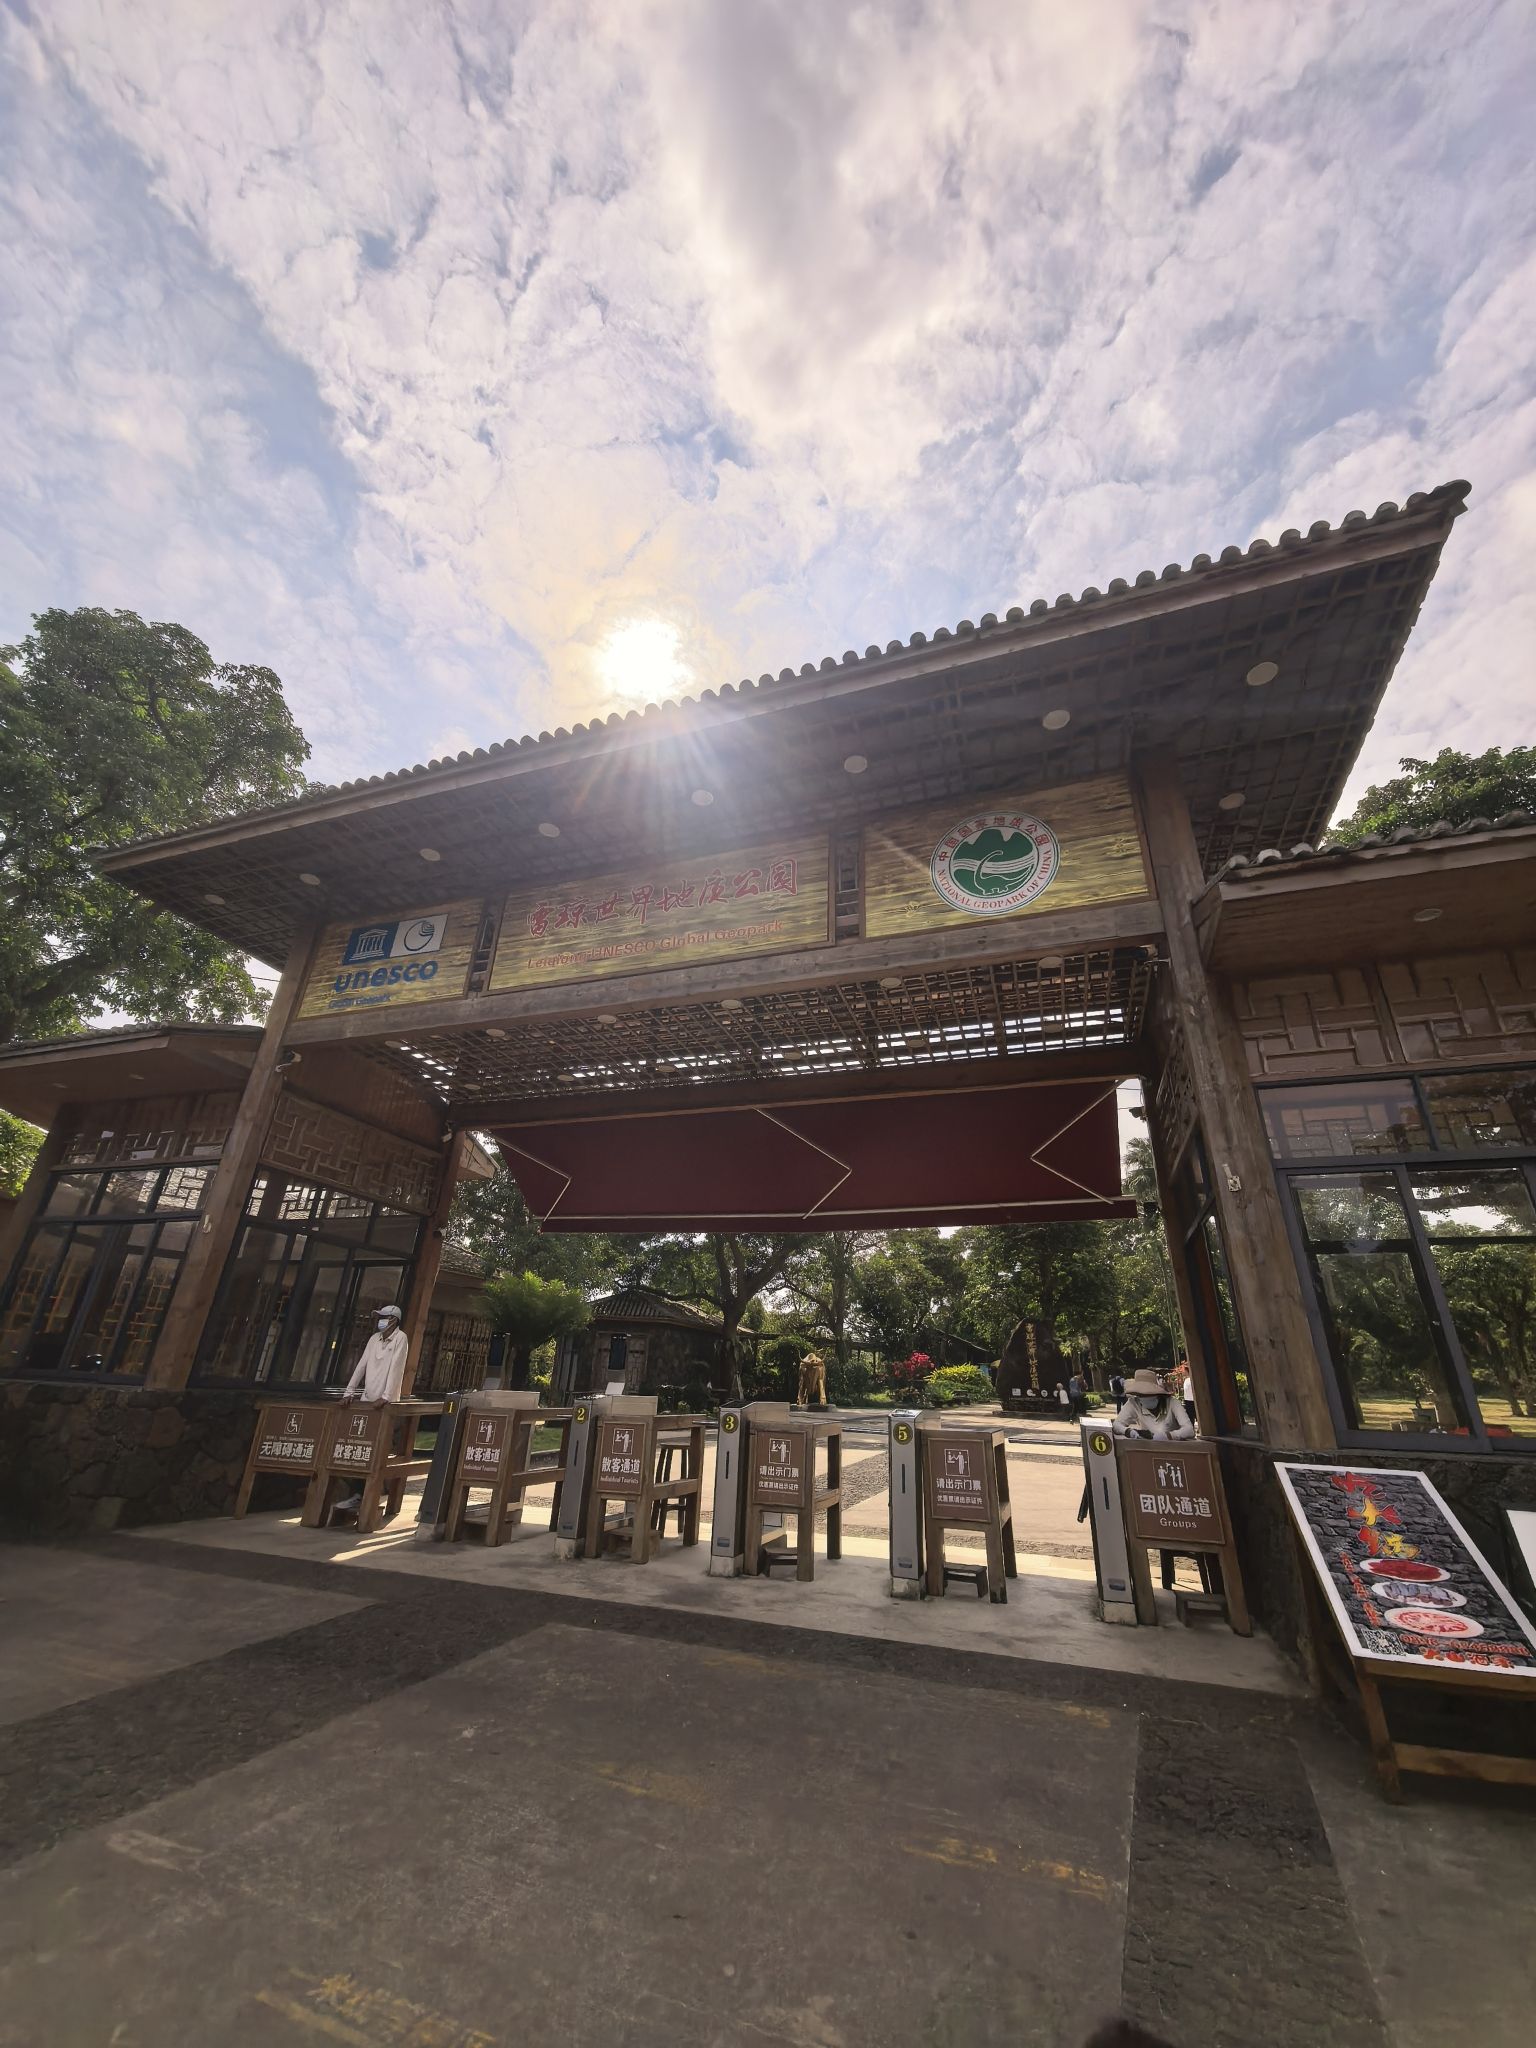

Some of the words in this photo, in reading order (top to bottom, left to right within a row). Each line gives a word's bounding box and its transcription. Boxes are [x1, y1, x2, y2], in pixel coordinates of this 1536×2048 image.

[937, 869, 971, 907] NATIONAL
[974, 891, 1026, 909] GEOPARK
[1027, 880, 1040, 893] OF
[1039, 850, 1052, 880] CHINA
[660, 931, 710, 950] Global
[714, 920, 783, 940] Geopark
[333, 960, 438, 993] unesco
[447, 1401, 454, 1414] 1
[576, 1407, 586, 1422] 2
[725, 1415, 735, 1431] 3
[898, 1426, 908, 1441] 5
[260, 1441, 315, 1459] 无障碍通道
[1095, 1435, 1107, 1452] 6
[333, 1444, 373, 1462] 散客通道
[465, 1446, 501, 1463] 散客通道
[601, 1456, 641, 1474] 散客通道
[759, 1465, 799, 1478] 请出示门票
[936, 1478, 982, 1491] 请出示门票
[1139, 1494, 1213, 1518] 团队通道
[1159, 1517, 1197, 1529] Groups
